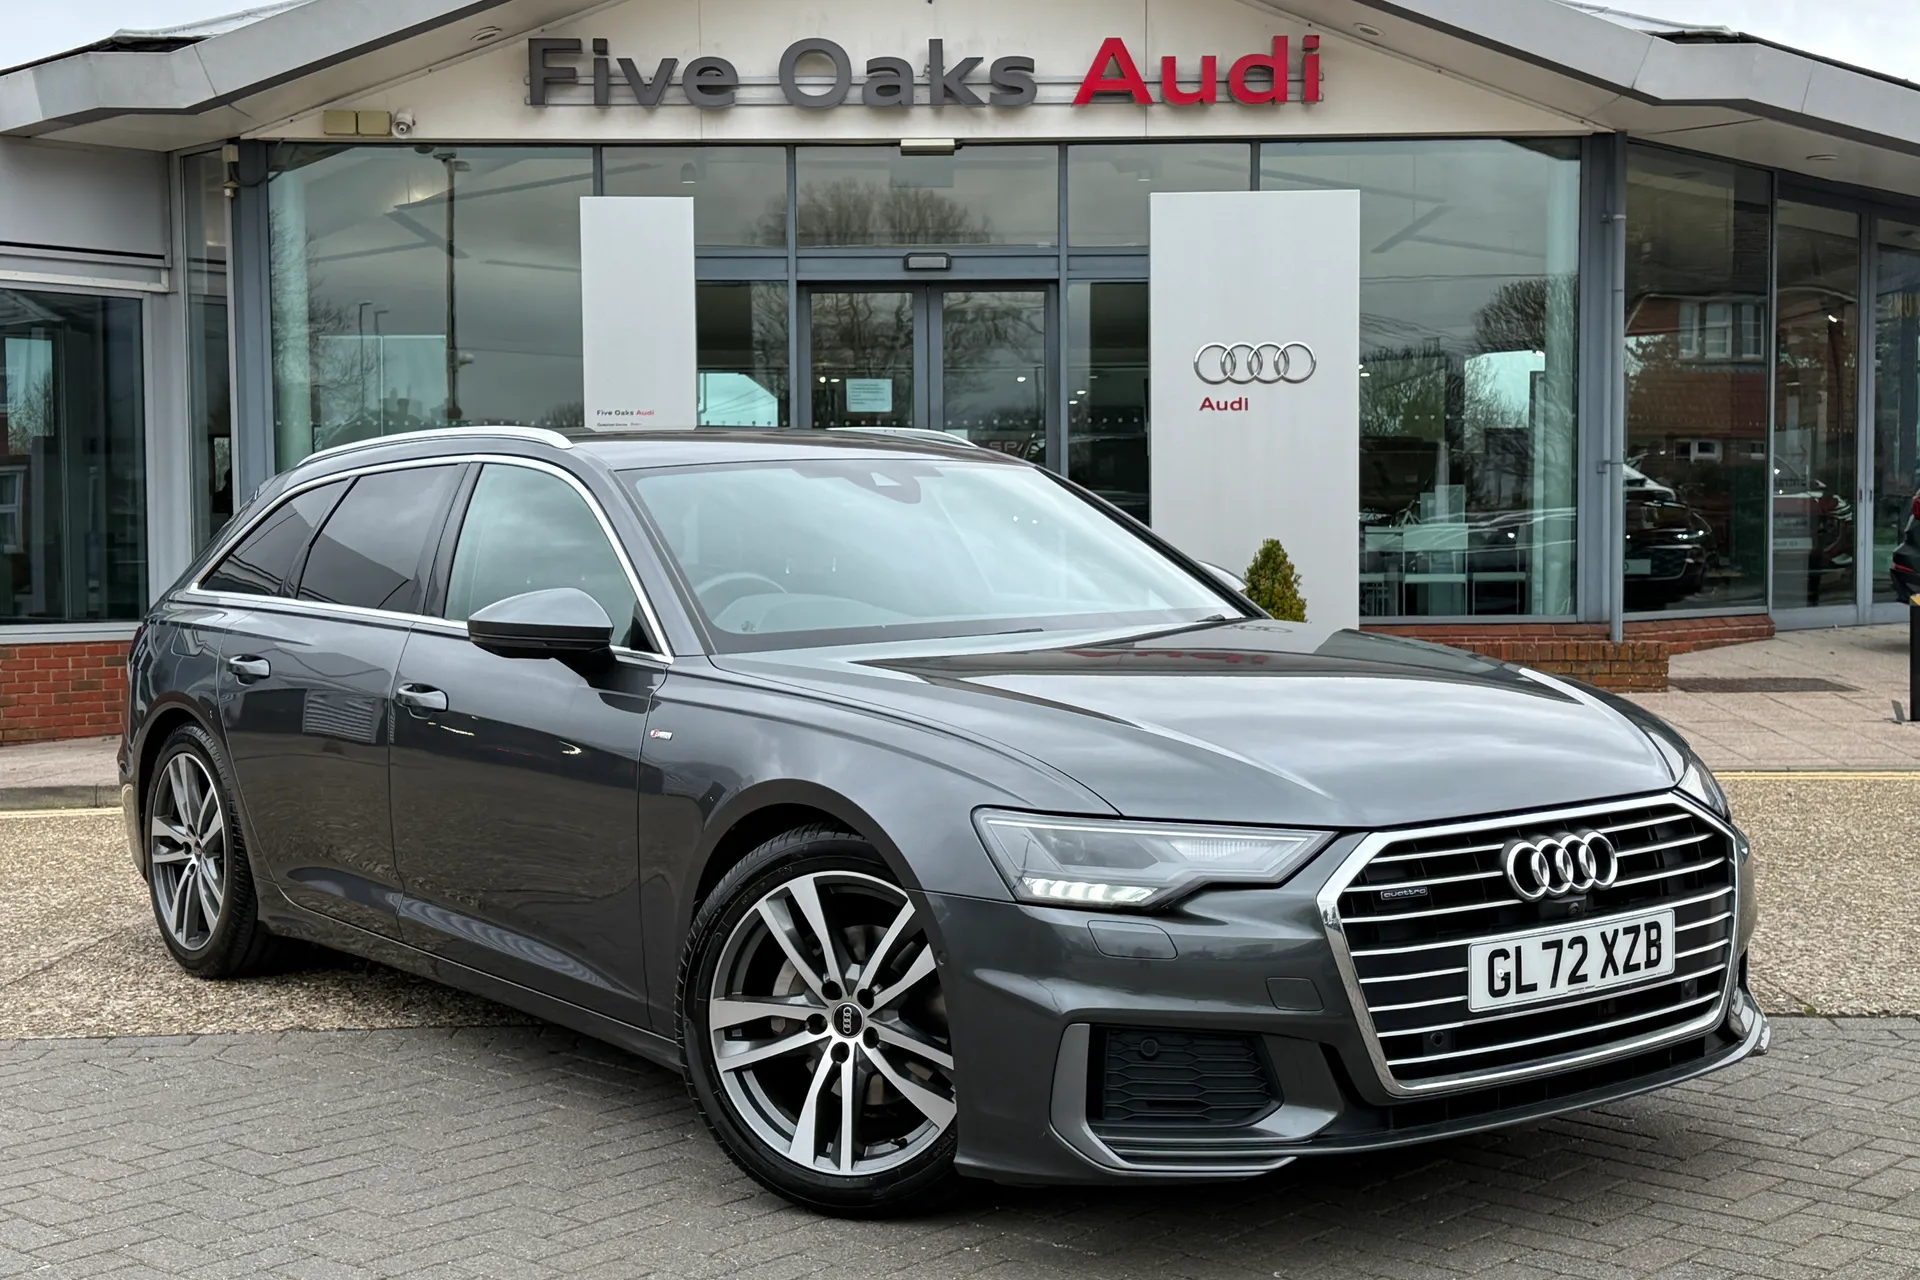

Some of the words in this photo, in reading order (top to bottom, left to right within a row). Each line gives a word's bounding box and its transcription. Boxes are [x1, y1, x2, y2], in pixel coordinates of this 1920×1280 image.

[528, 37, 739, 108] Five
[779, 37, 1038, 108] Oaks
[1072, 35, 1320, 105] Audi
[1199, 397, 1249, 411] Audi
[1383, 888, 1426, 898] quattro
[1487, 935, 1588, 999] GL72
[1600, 920, 1662, 979] XZB
